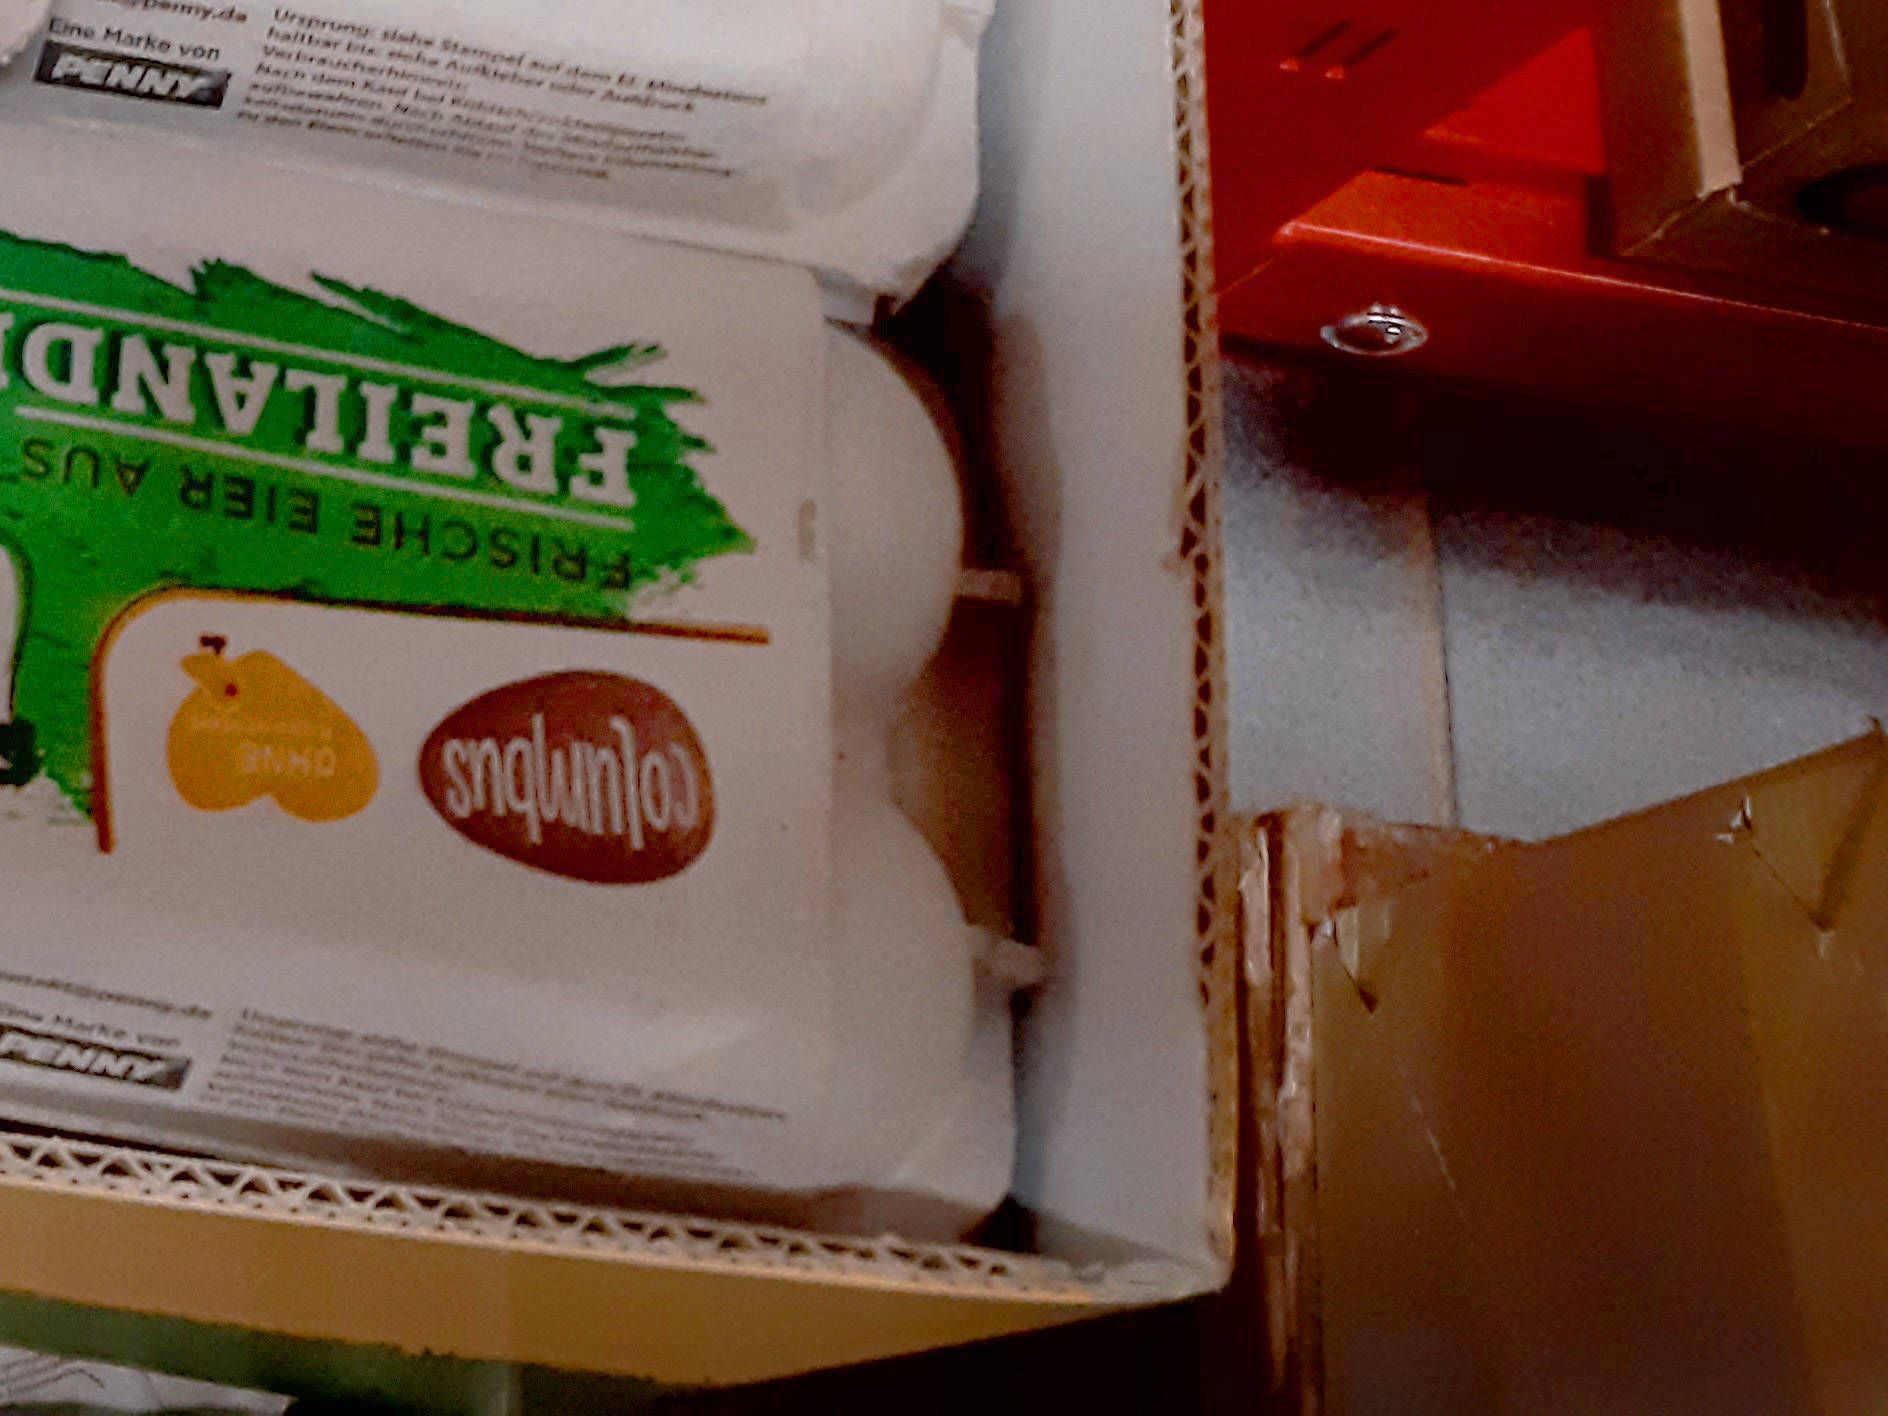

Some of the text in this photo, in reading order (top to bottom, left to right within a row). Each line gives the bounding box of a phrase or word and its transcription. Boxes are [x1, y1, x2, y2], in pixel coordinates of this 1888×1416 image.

[47, 17, 221, 63] Eine Marke von
[51, 52, 208, 100] PENNY
[23, 438, 632, 590] FRISCHE EIER AUS
[442, 713, 698, 851] columbus
